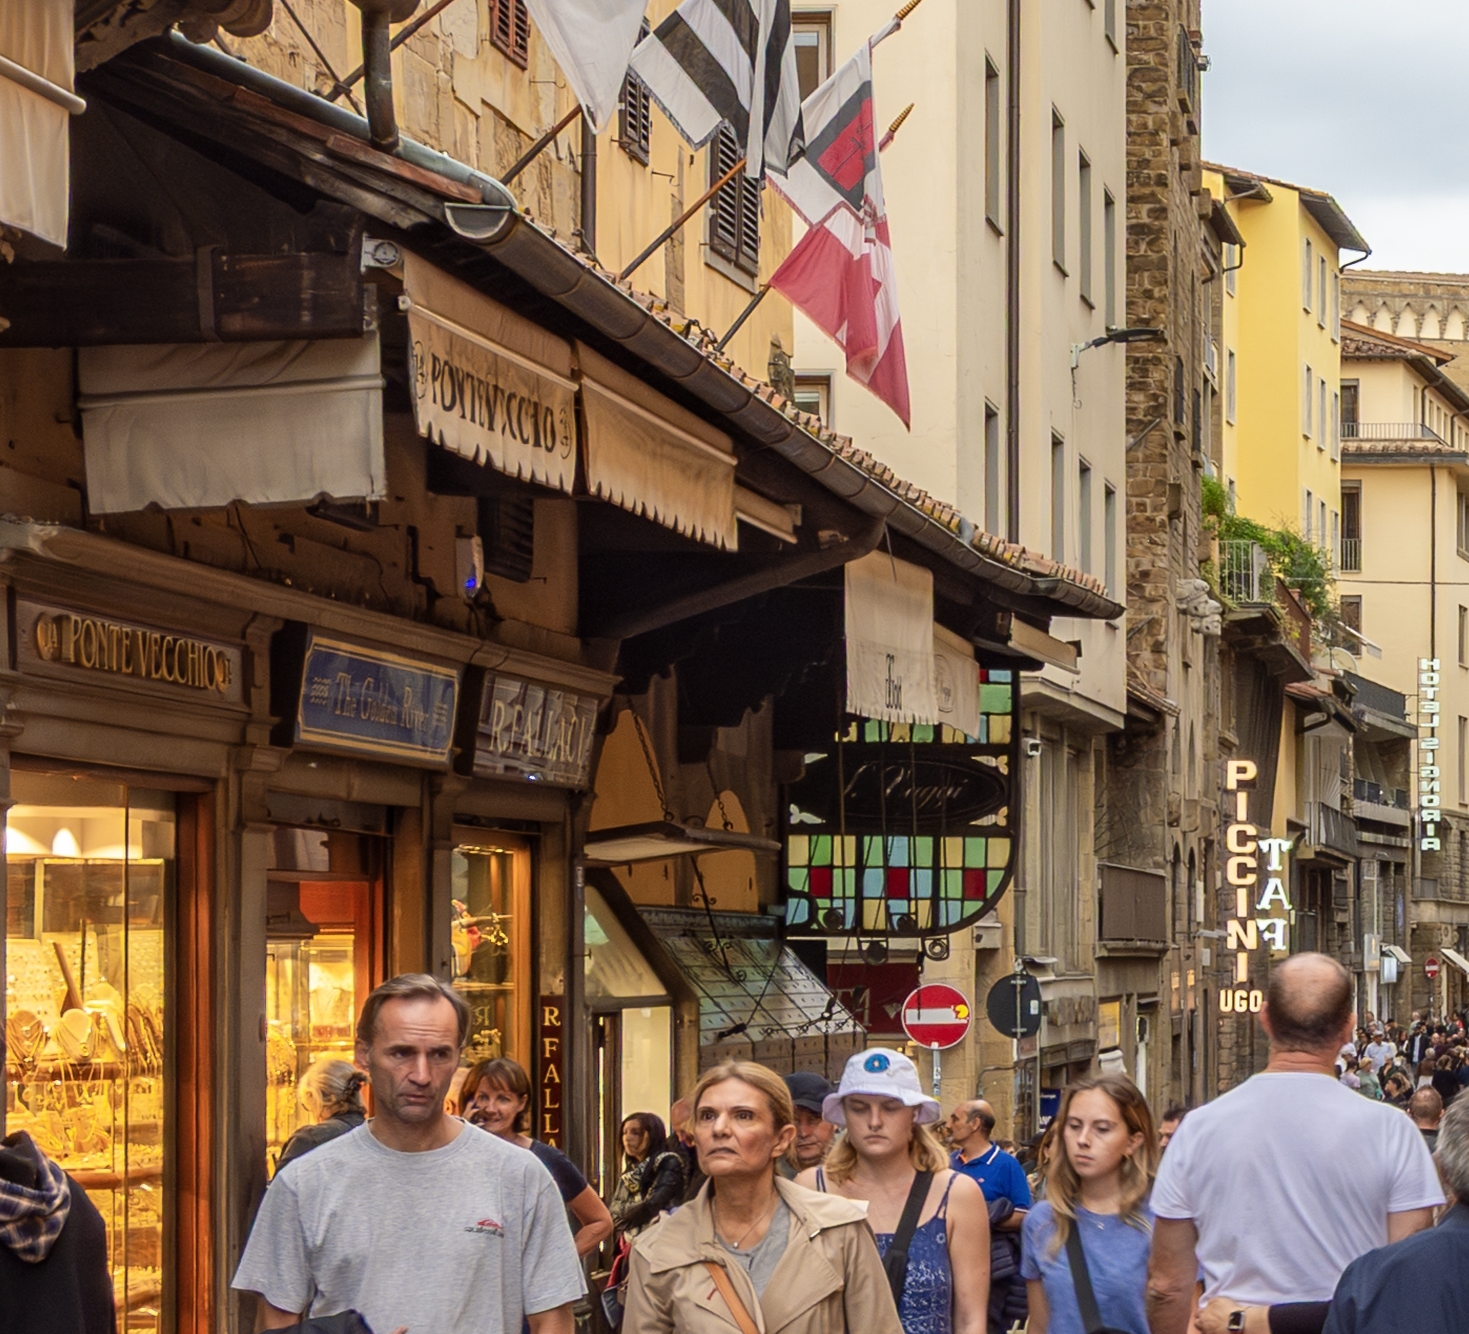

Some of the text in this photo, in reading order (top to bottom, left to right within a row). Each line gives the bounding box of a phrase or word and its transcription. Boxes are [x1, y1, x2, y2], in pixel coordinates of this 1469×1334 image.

[69, 616, 133, 674] PONTE
[136, 630, 219, 690] VECCHIO
[335, 671, 357, 717] The
[1226, 760, 1258, 983] PICCINI
[542, 1006, 561, 1026] R
[1219, 989, 1263, 1013] UGO
